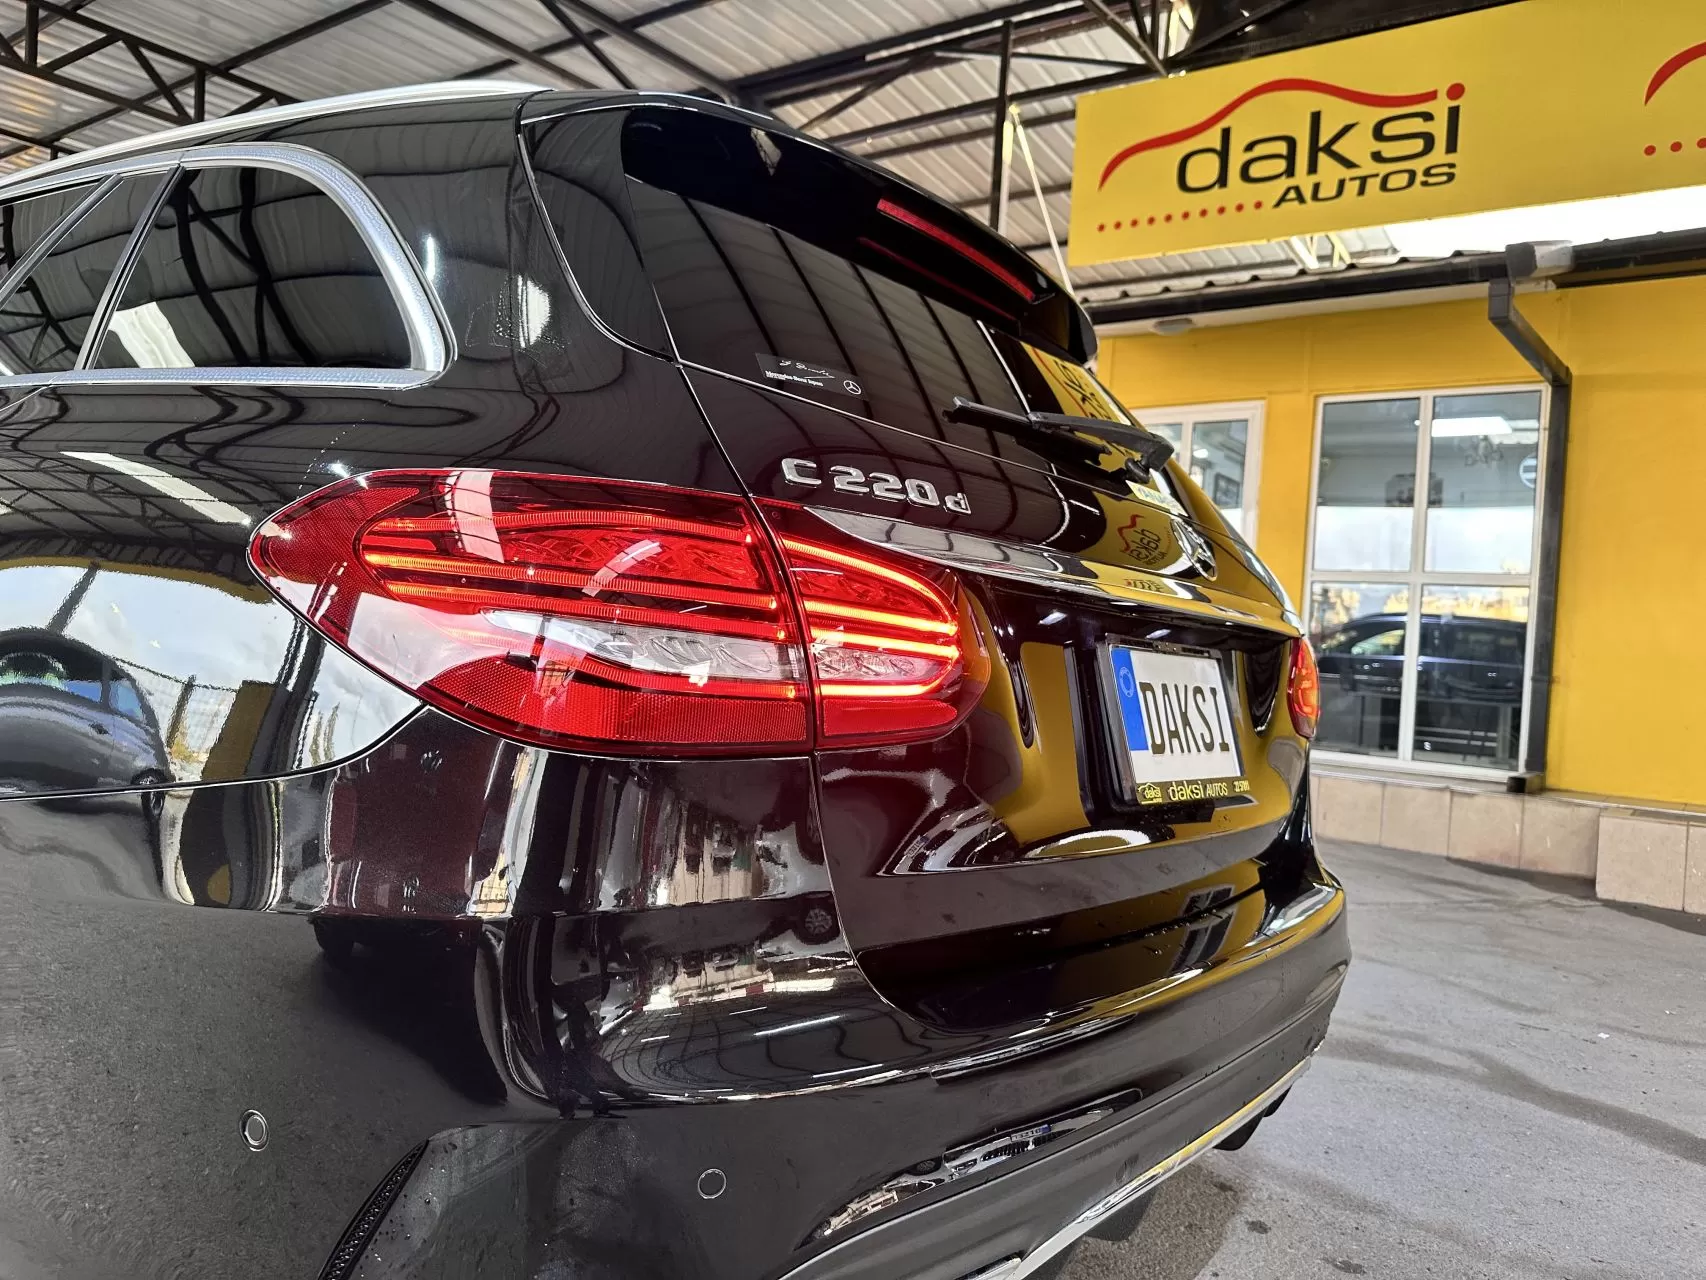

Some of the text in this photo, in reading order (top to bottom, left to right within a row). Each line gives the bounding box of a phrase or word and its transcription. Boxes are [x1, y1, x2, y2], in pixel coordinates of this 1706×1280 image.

[1176, 82, 1465, 195] daksi
[1273, 162, 1457, 208] AUTOS
[781, 457, 972, 515] C 220 d
[1138, 681, 1230, 755] DAKSI
[1168, 780, 1205, 801] daksi
[1205, 782, 1228, 798] AUTOS
